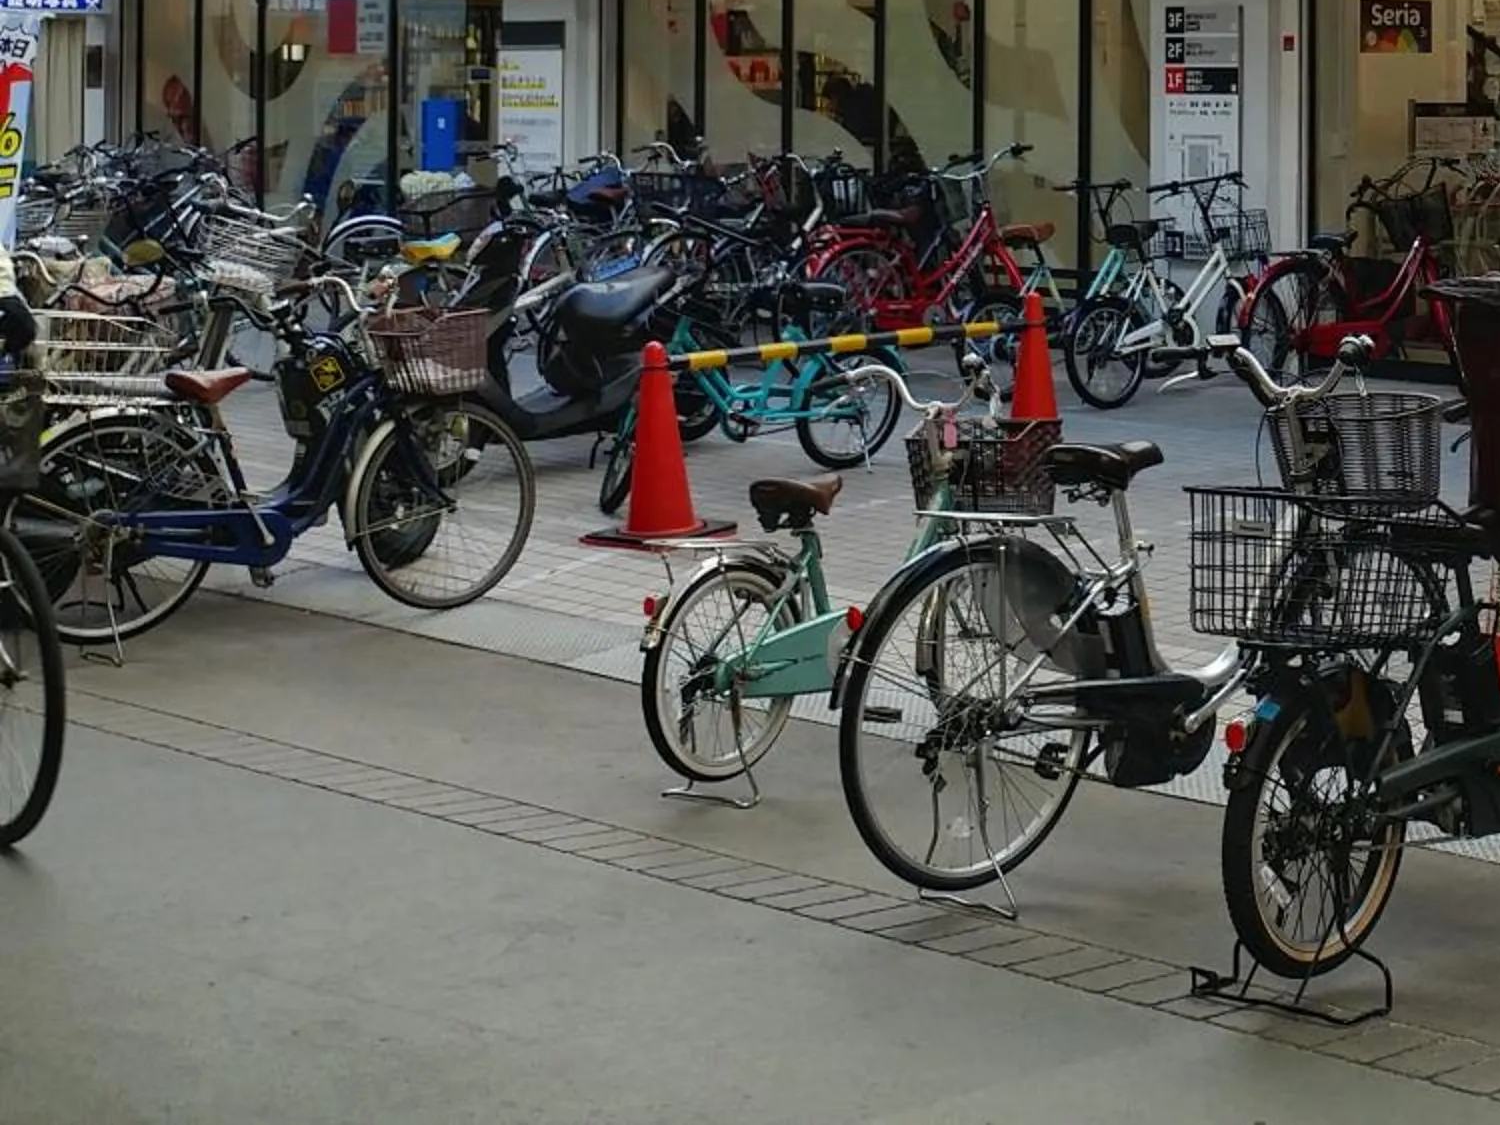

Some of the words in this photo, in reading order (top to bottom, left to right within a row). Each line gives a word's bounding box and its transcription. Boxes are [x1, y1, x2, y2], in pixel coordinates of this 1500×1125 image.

[1167, 12, 1183, 28] 3F
[1371, 3, 1421, 26] Seria
[1167, 42, 1183, 58] 2F
[1167, 72, 1183, 89] 1F
